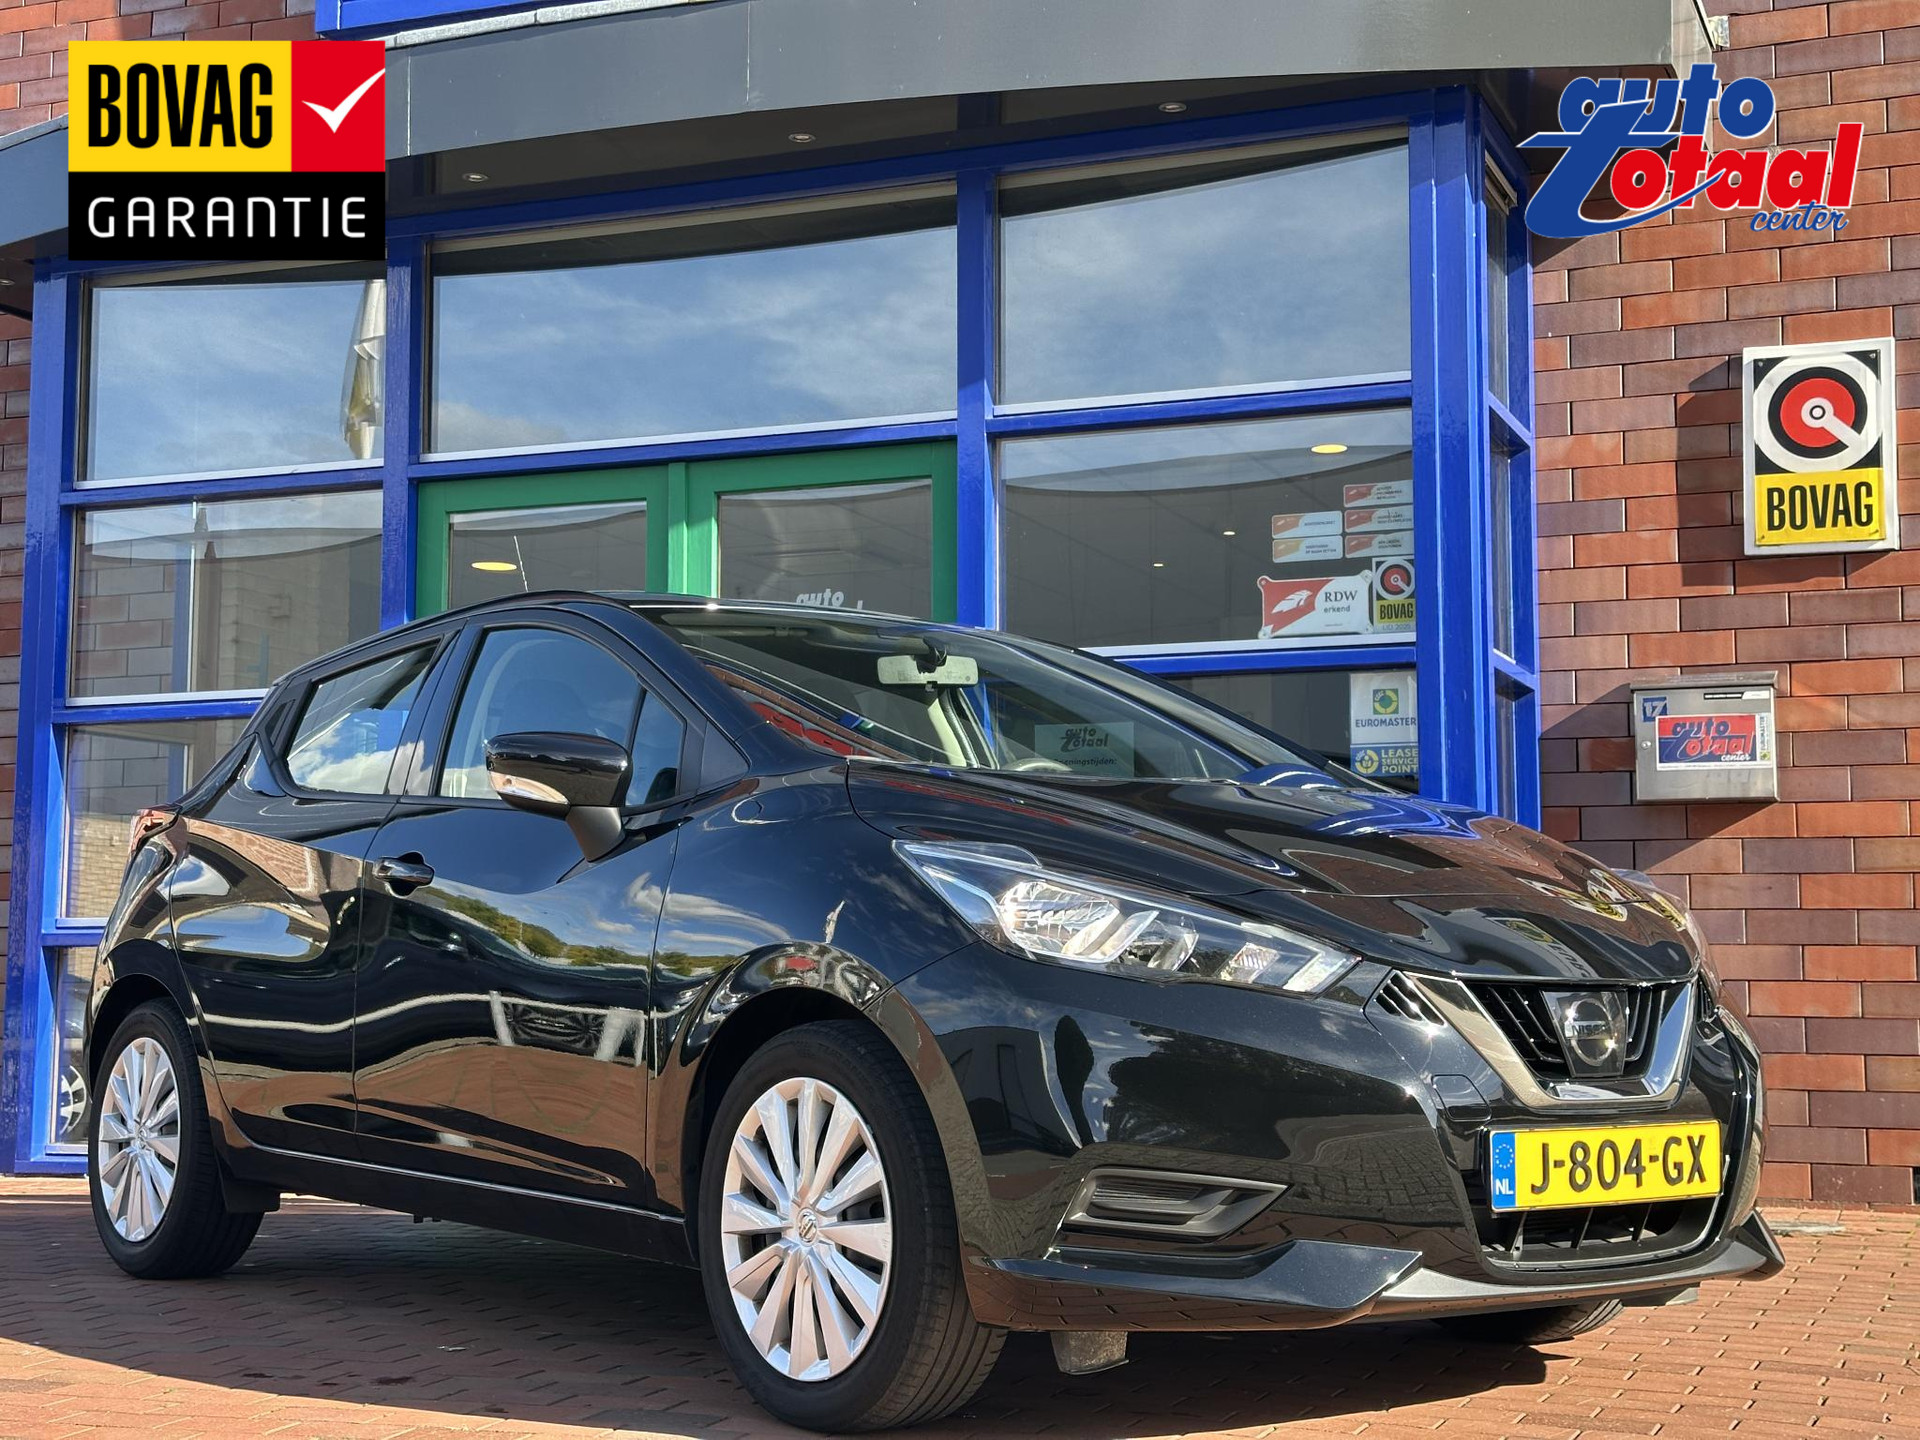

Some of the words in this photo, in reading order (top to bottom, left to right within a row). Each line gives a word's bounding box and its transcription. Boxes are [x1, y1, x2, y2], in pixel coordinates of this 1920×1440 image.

[1767, 481, 1873, 531] BOVAG
[796, 589, 844, 606] auto
[1324, 590, 1358, 603] RDW
[1324, 605, 1351, 614] erkend
[1380, 602, 1414, 620] BOVAG
[1644, 701, 1667, 717] 17
[1355, 717, 1417, 727] EUROMASTER
[1672, 718, 1730, 736] auto
[1065, 727, 1096, 736] auto
[1381, 749, 1418, 757] LEASE
[1721, 751, 1750, 761] center
[1381, 757, 1418, 765] SERVICE
[1382, 765, 1418, 773] POINT
[1531, 1135, 1706, 1195] J-804-GX
[1495, 1179, 1514, 1195] NL
